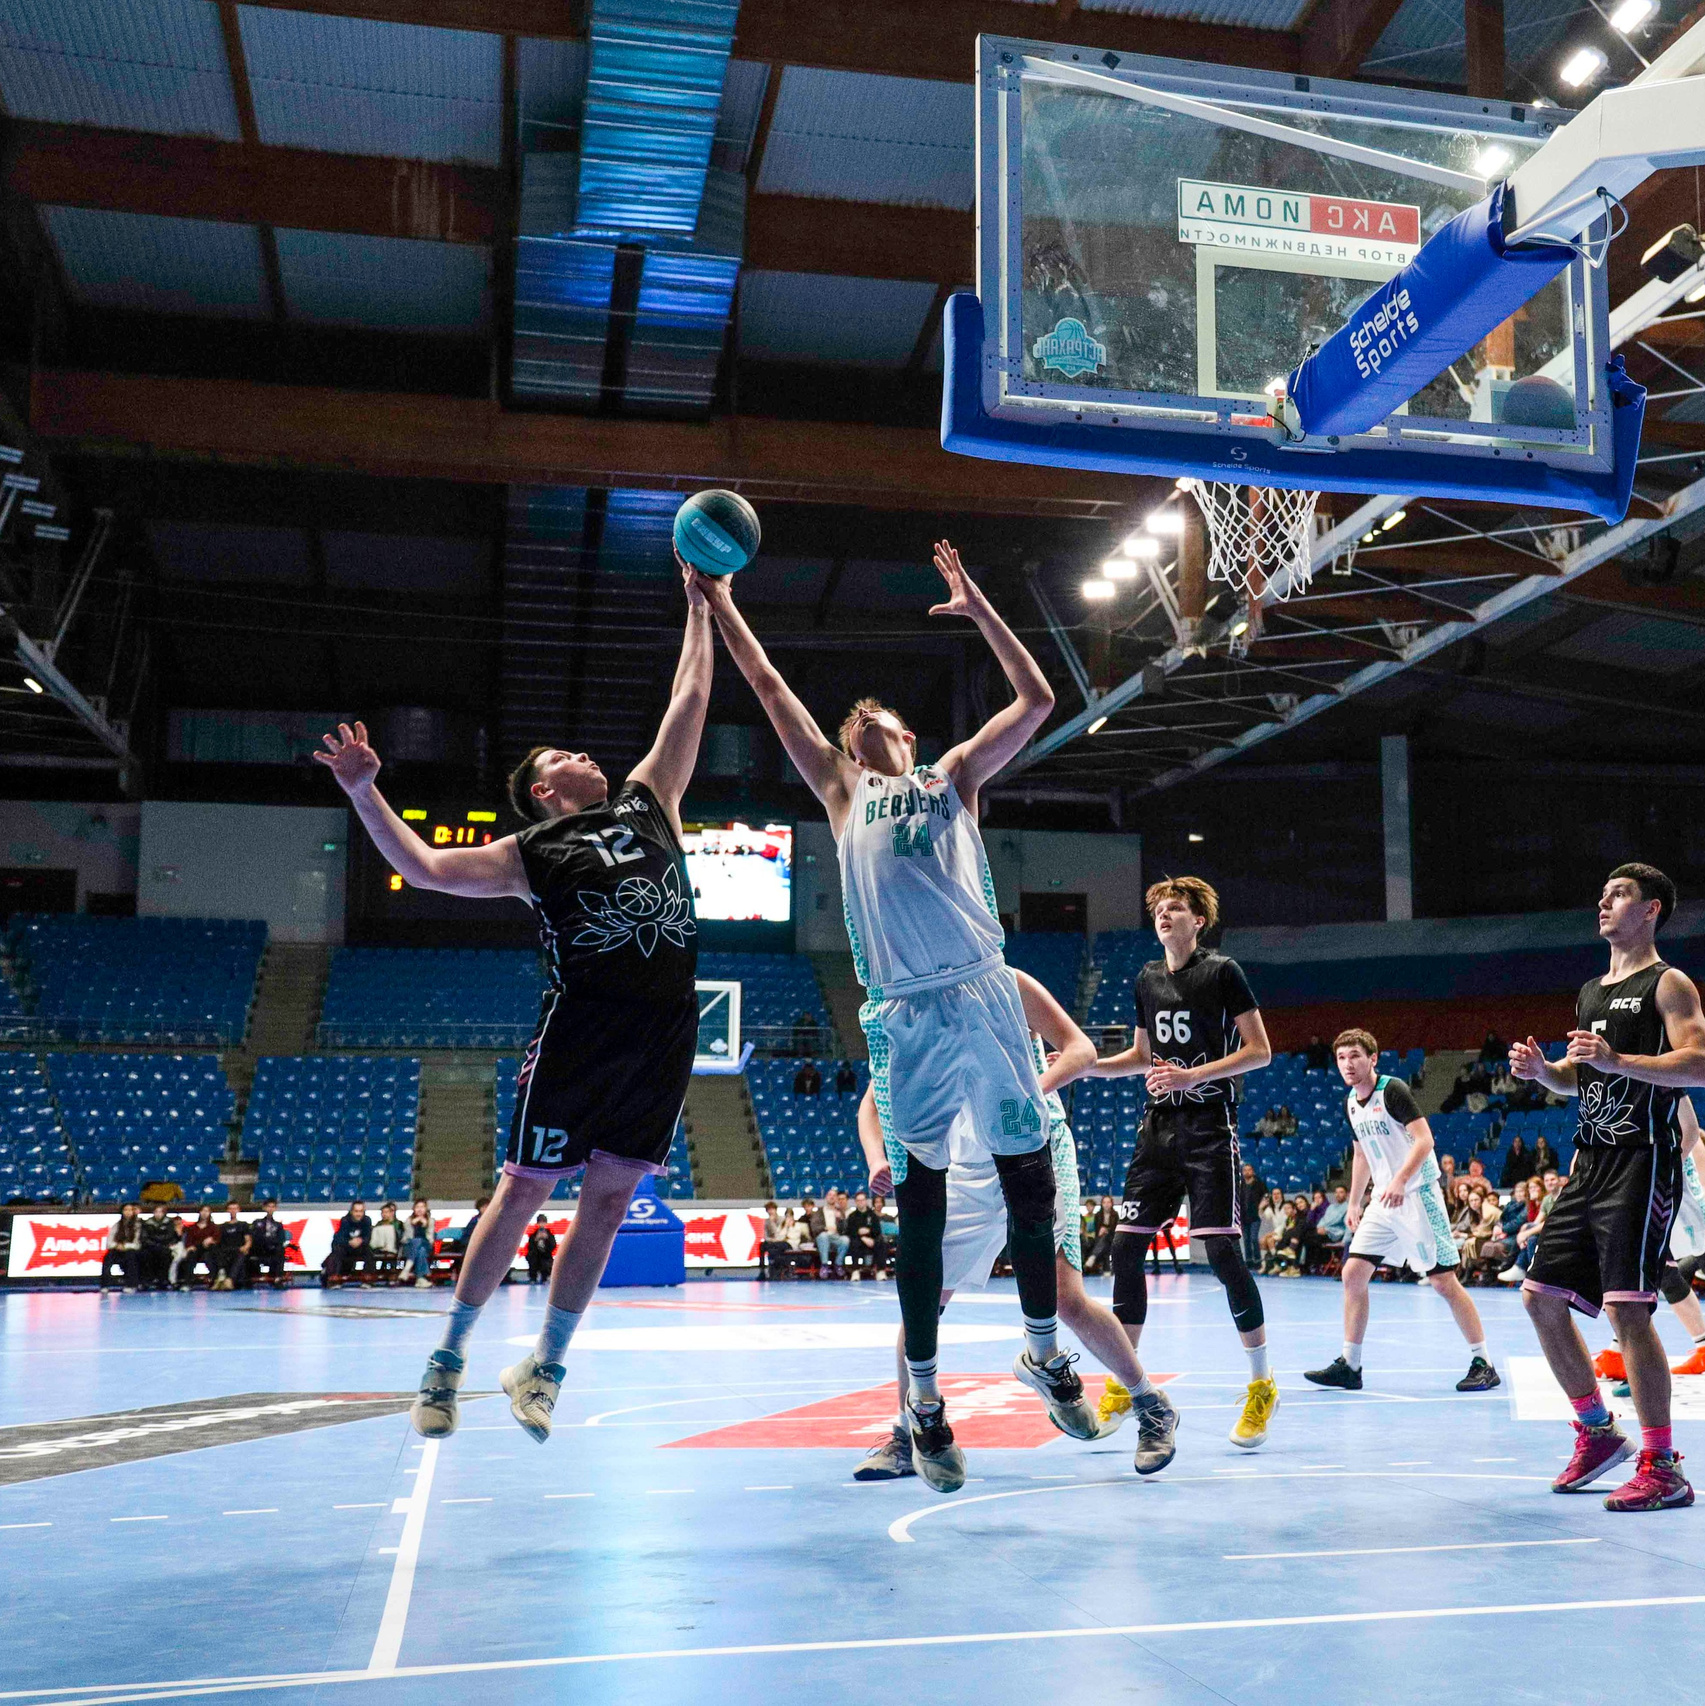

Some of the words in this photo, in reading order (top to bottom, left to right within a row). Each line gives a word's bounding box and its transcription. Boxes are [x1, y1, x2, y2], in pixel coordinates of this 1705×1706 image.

[1350, 289, 1411, 357] Schelde
[1356, 311, 1419, 379] Sports
[1212, 461, 1243, 469] Schelde
[1244, 463, 1271, 474] Sports
[866, 788, 950, 826] BEAVERS
[434, 826, 475, 844] 0:11
[582, 824, 646, 868] 12
[892, 821, 934, 857] 24
[1154, 1010, 1192, 1044] 66
[1000, 1096, 1041, 1135] 24
[532, 1125, 569, 1163] 12
[41, 1236, 100, 1254] Альфа
